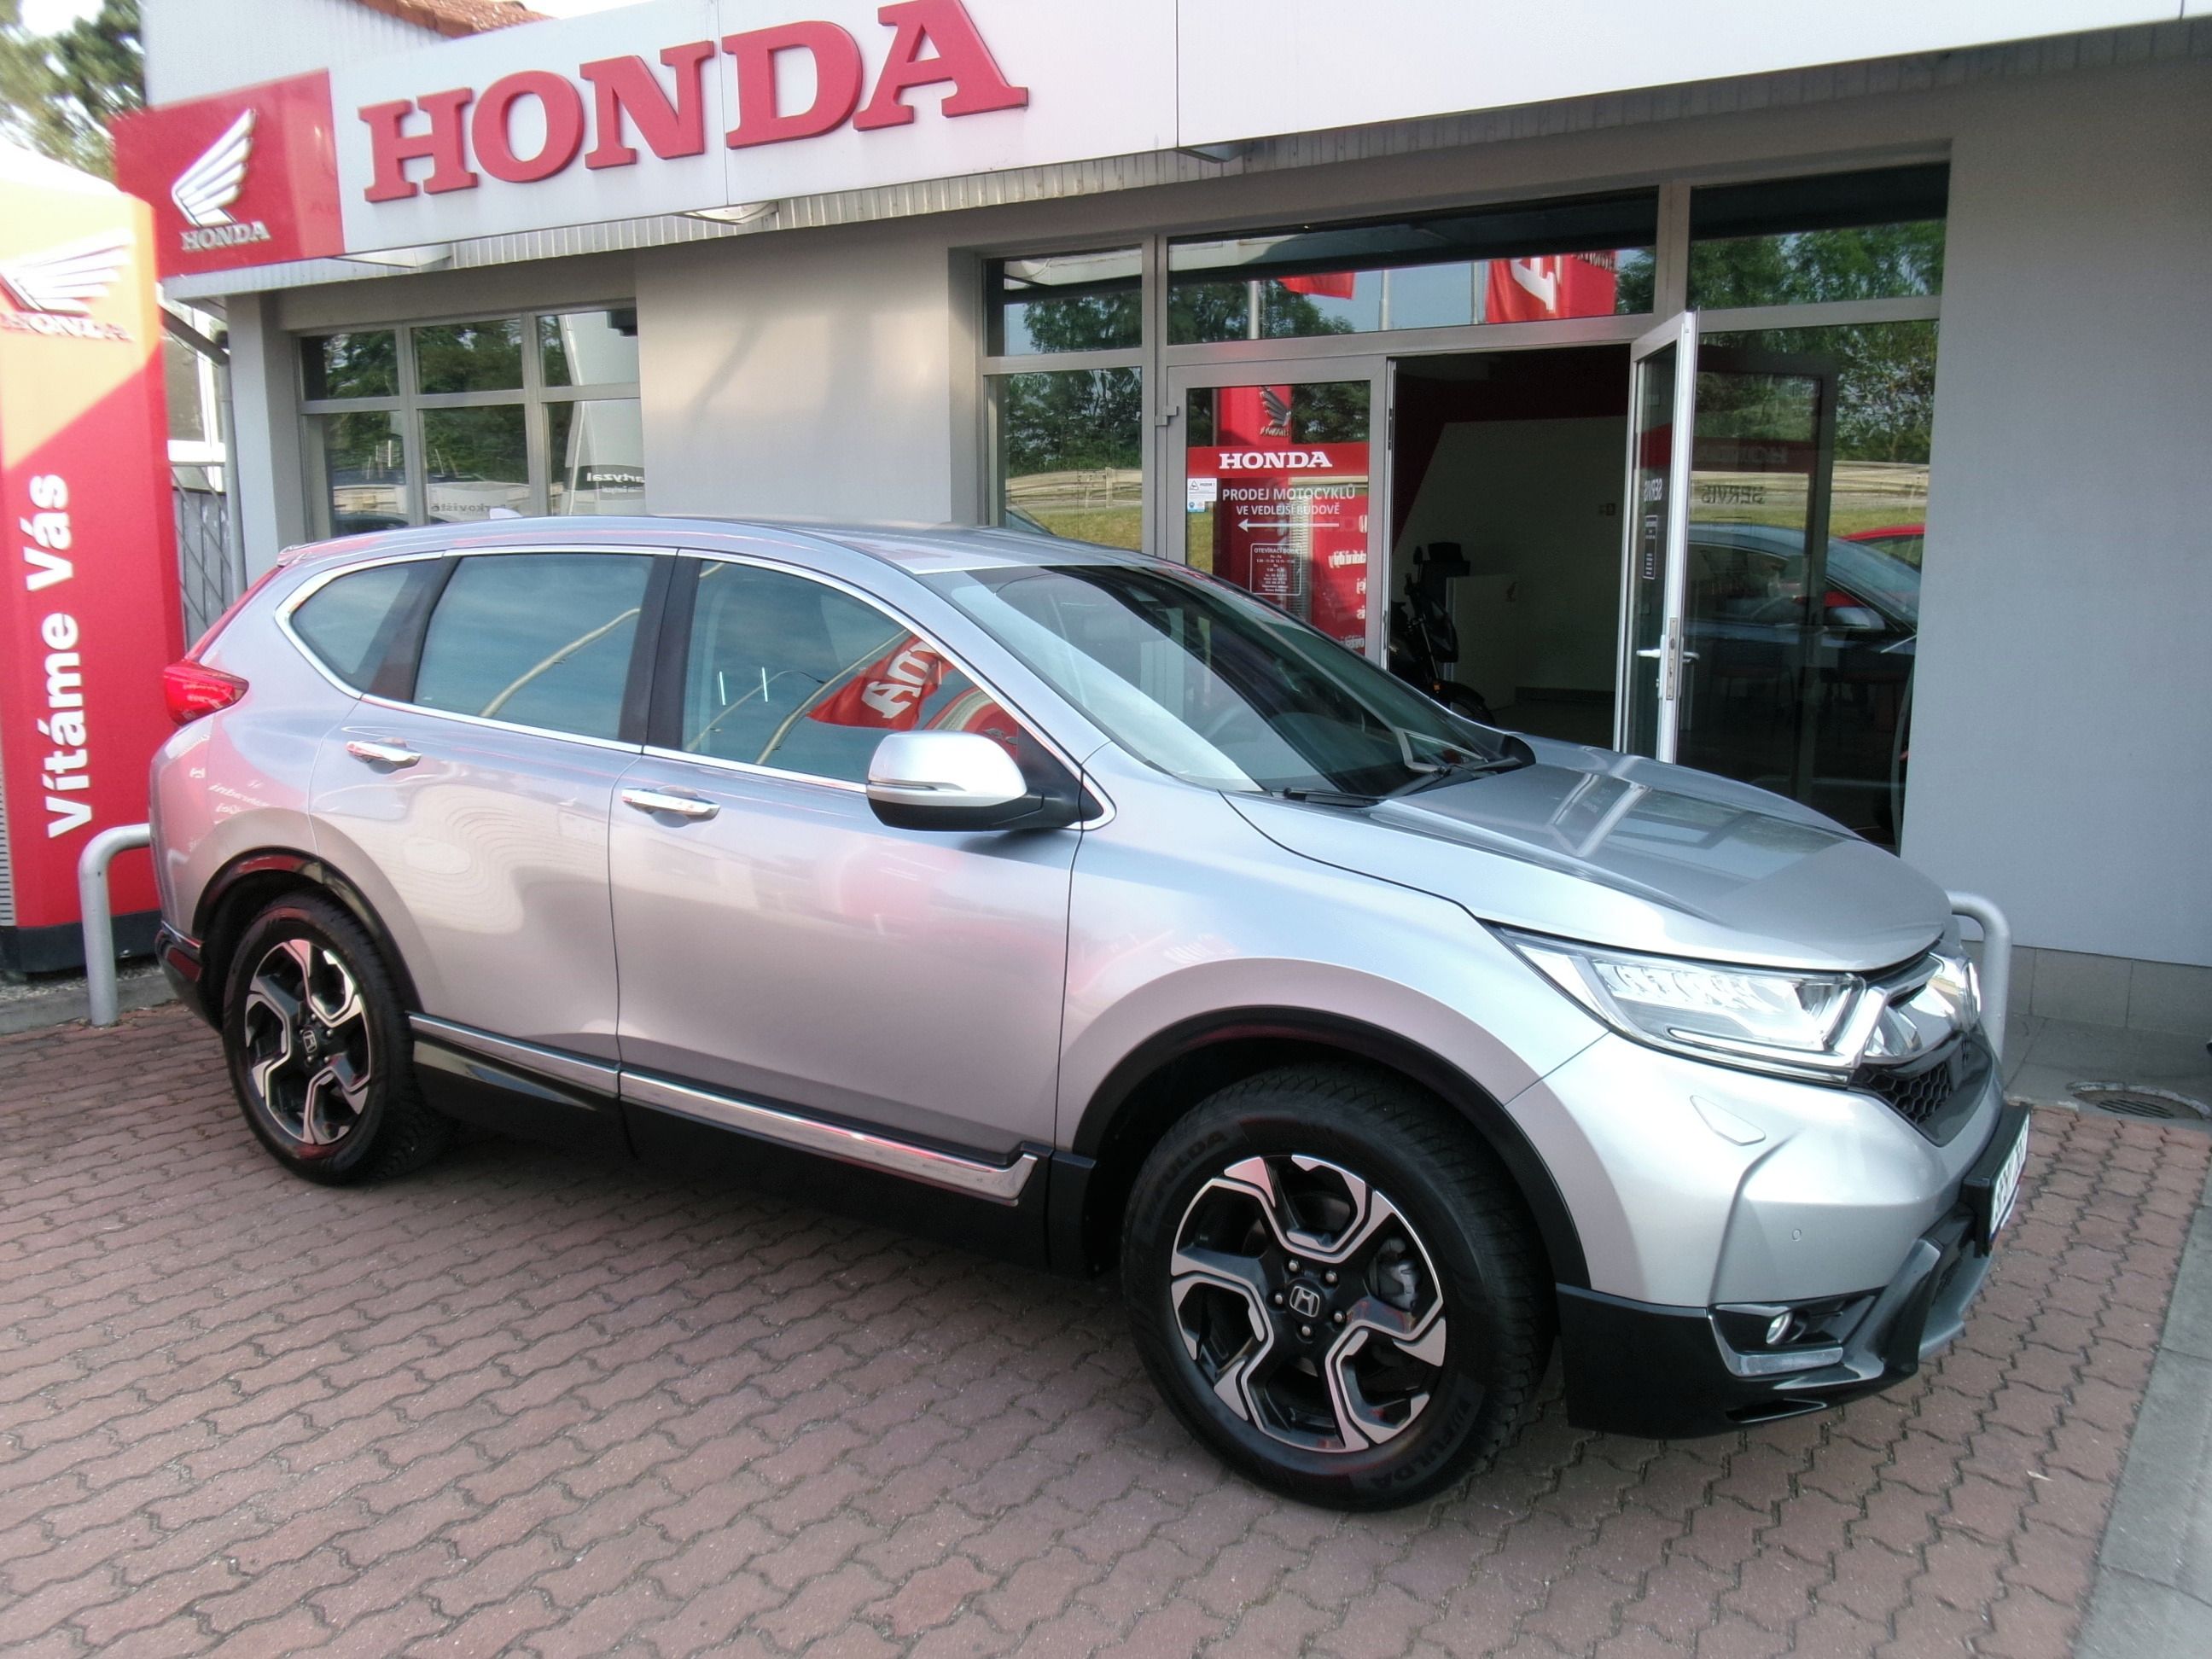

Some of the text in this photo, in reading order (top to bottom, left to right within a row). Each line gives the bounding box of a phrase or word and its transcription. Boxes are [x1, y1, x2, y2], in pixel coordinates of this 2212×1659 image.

[358, 0, 1029, 204] HONDA
[180, 220, 271, 252] HONDA
[1219, 451, 1333, 469] HONDA
[1222, 488, 1269, 502] PRODEJ
[1273, 483, 1356, 500] MOTOCYKLŮ
[1236, 501, 1340, 515] VE VEDLEJŠÍ BUDOVĚ
[20, 474, 93, 839] Vítáme Vás
